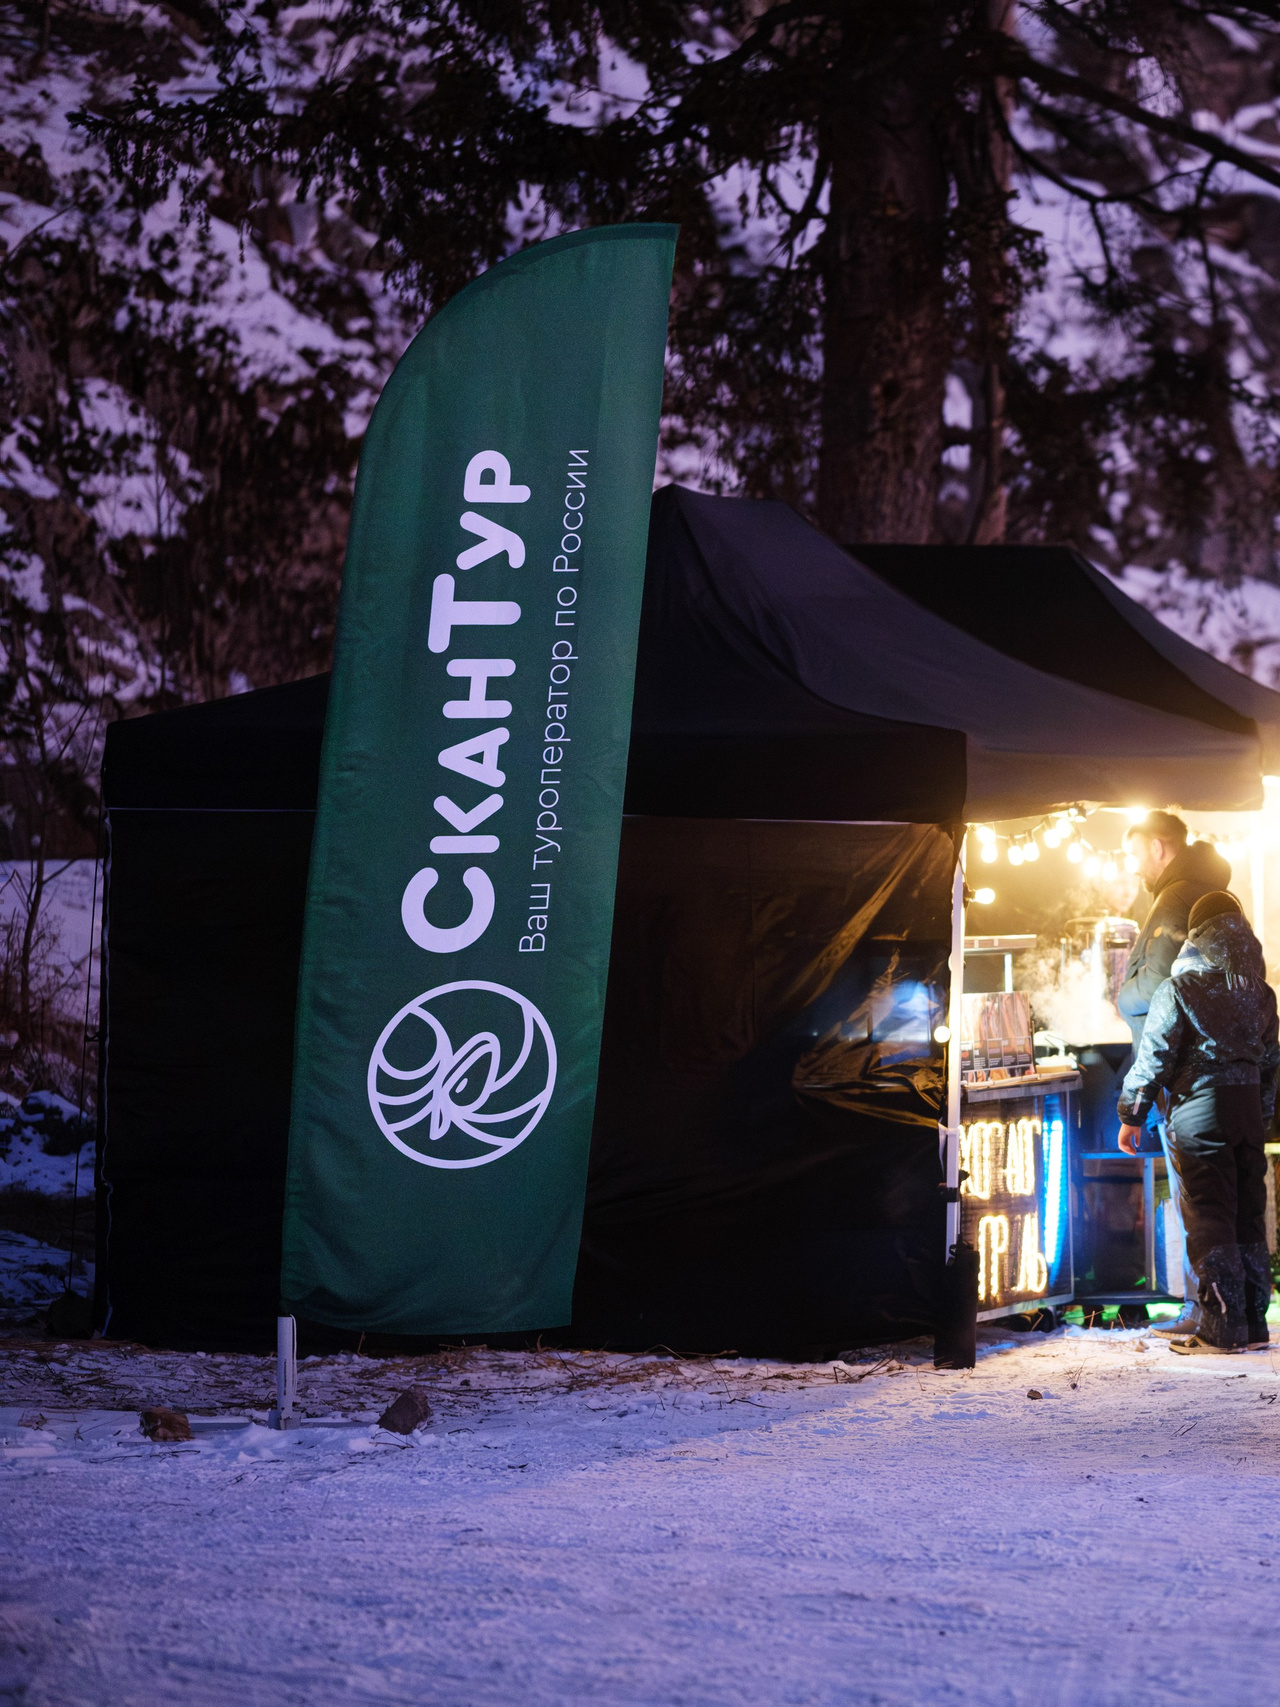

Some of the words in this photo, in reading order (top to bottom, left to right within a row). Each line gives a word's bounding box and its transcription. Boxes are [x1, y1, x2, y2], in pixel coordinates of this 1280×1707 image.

[552, 449, 589, 573] России
[554, 585, 578, 627] по
[532, 639, 579, 871] туроператор
[518, 883, 552, 953] Ваш
